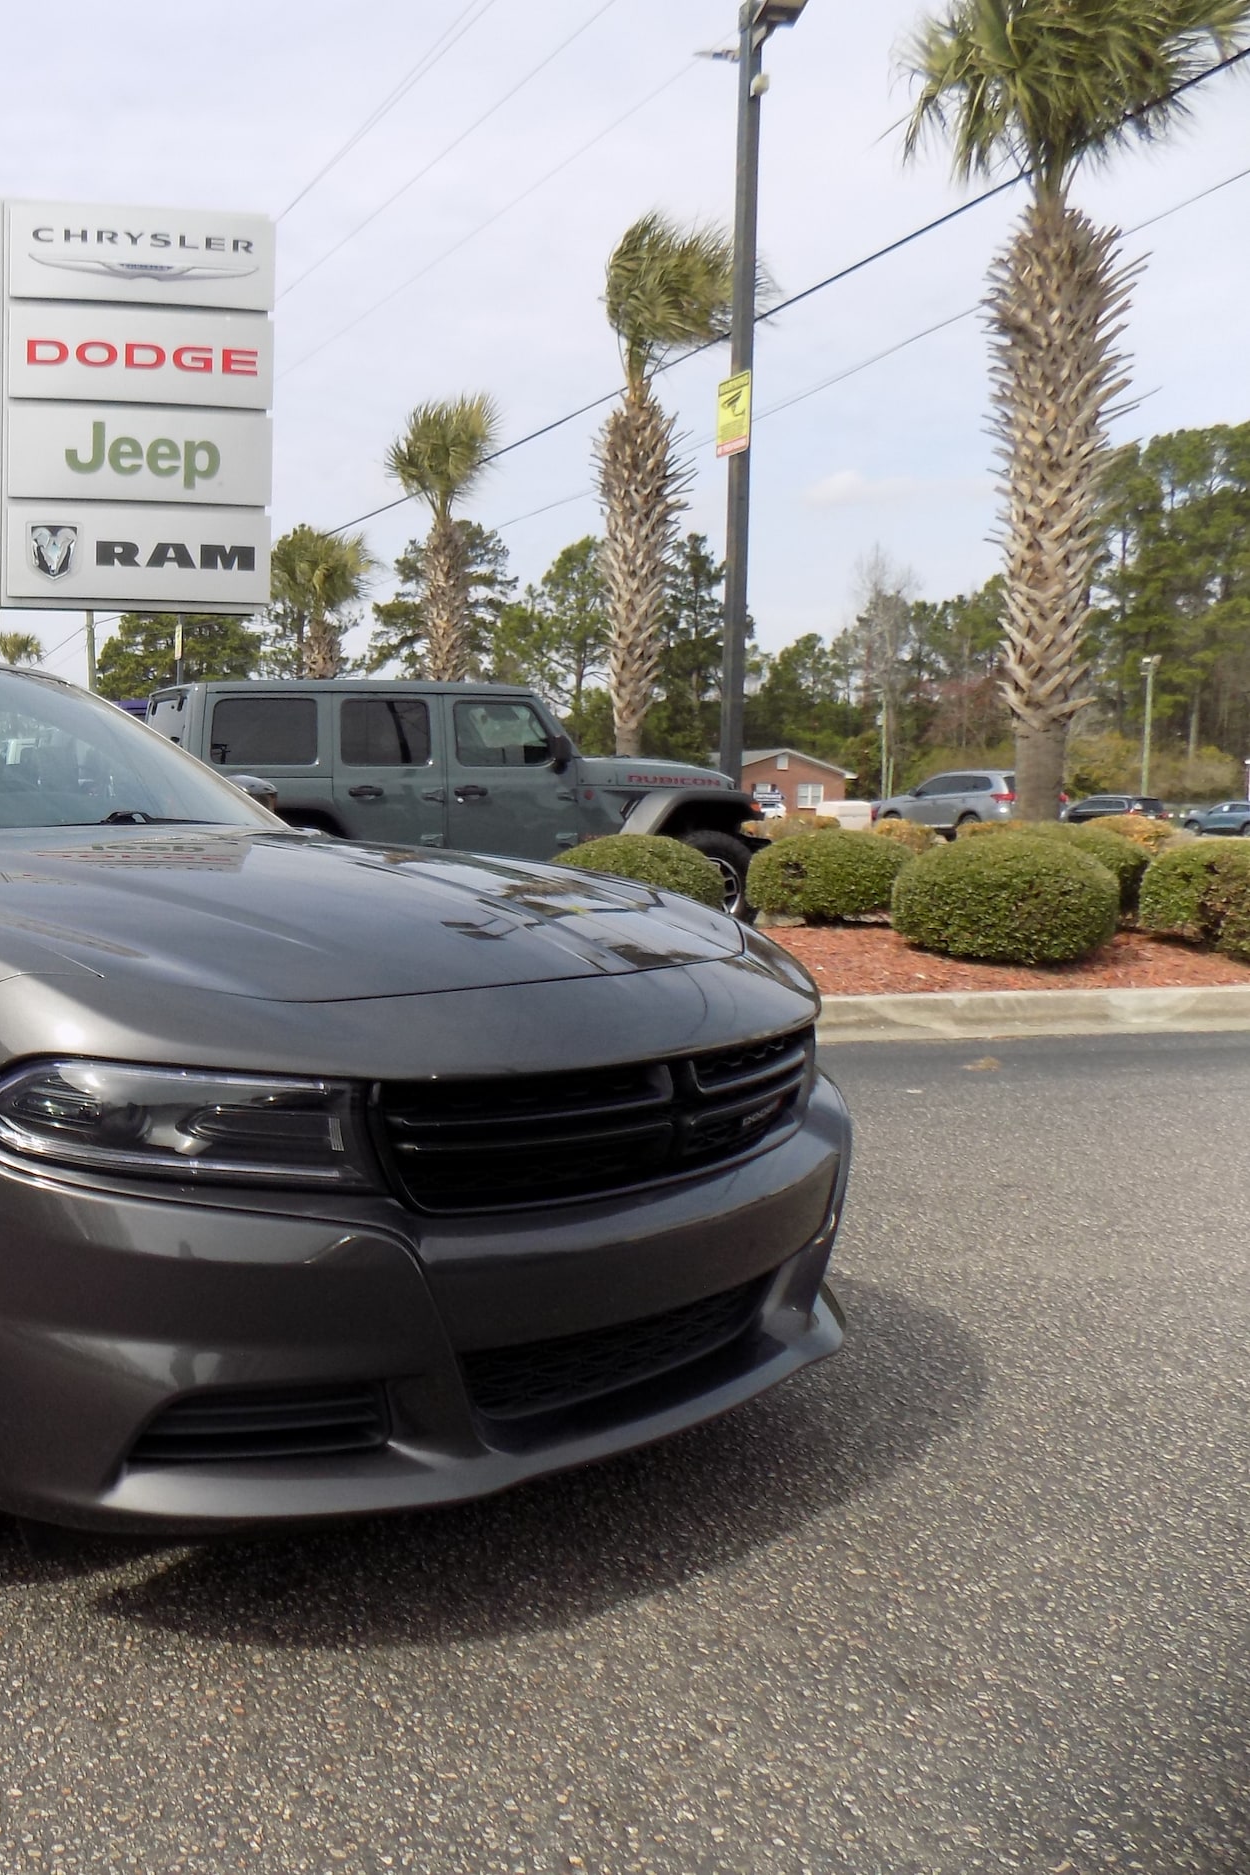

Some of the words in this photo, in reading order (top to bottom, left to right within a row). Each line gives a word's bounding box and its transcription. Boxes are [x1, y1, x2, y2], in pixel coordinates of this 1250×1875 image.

[32, 227, 255, 254] CHRYSLER
[27, 339, 258, 377] DODGE
[65, 421, 221, 489] Jeep
[96, 541, 256, 571] RAM
[628, 775, 720, 786] RUBICON
